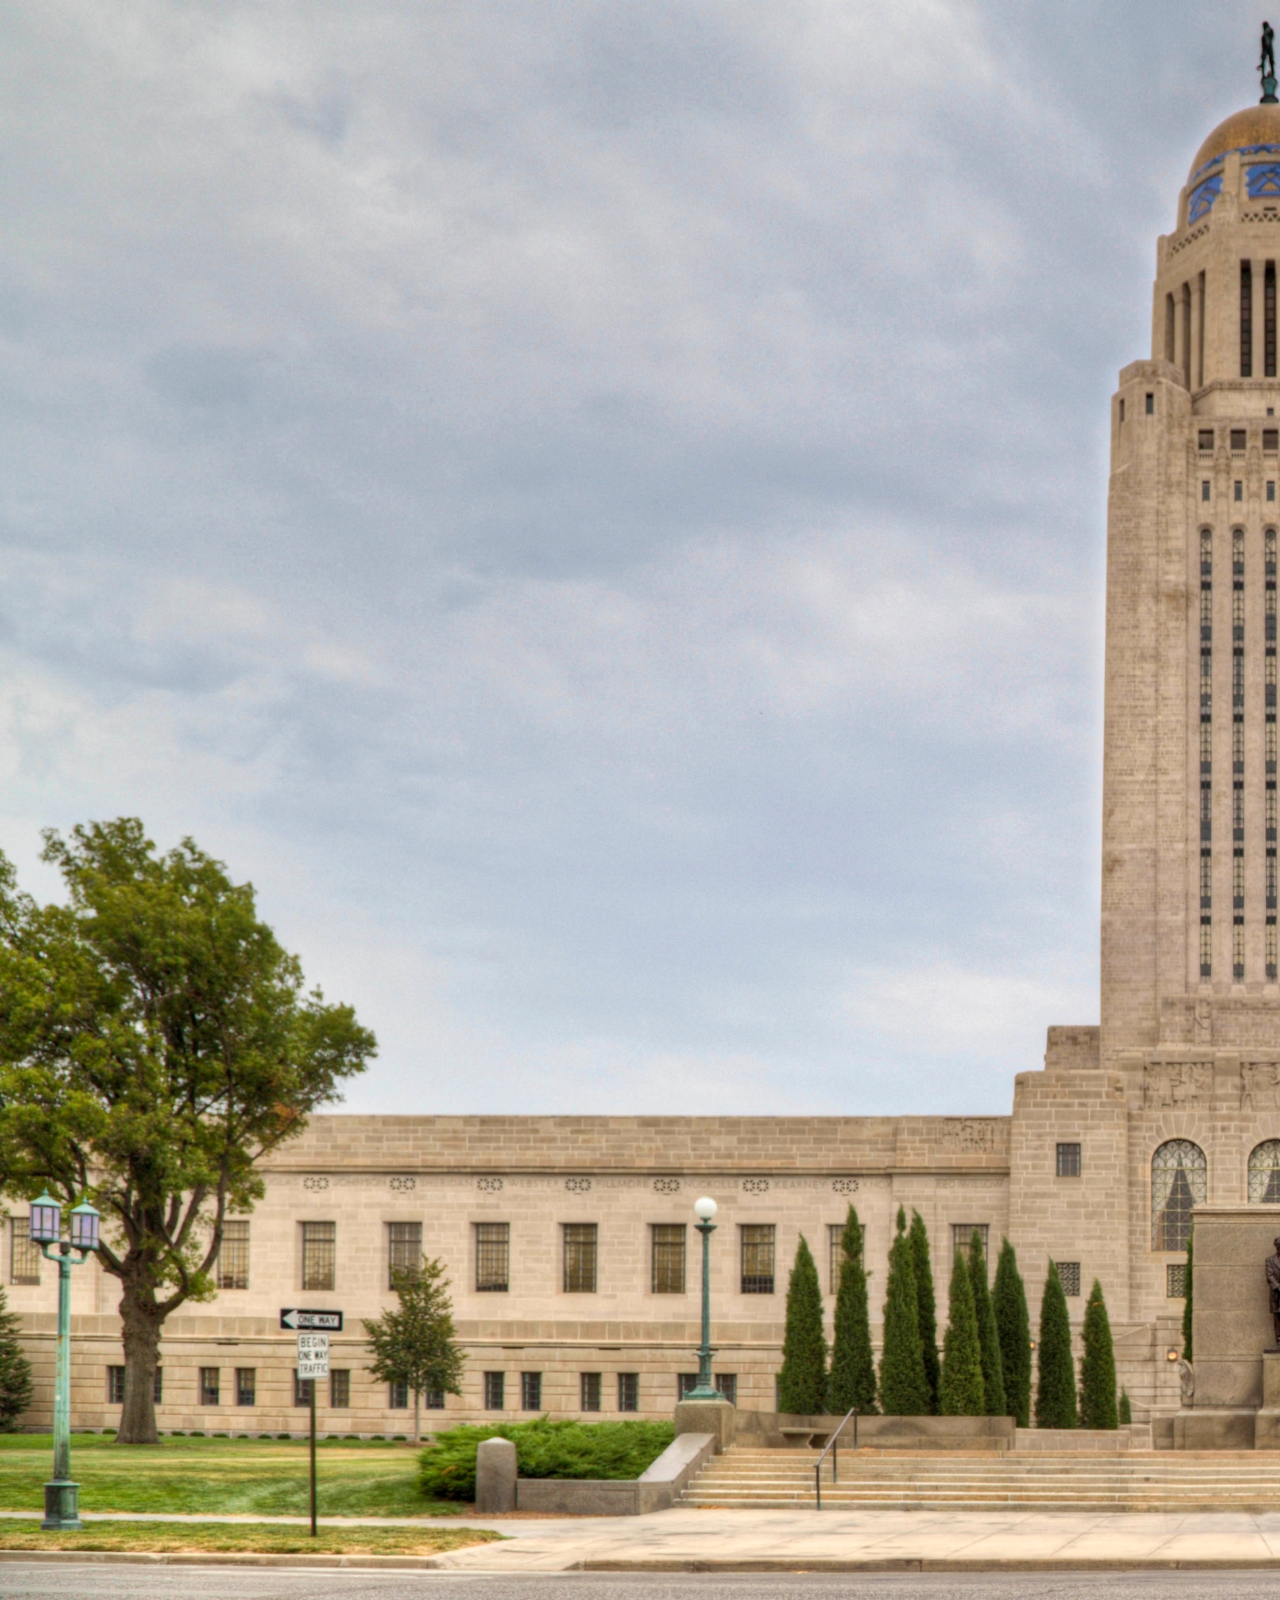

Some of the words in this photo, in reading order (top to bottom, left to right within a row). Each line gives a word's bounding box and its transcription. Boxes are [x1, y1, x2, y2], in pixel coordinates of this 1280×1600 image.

[331, 1178, 386, 1188] JOHNSON
[420, 1178, 473, 1188] SHERIDAN
[508, 1179, 559, 1188] WEBSTER
[596, 1179, 649, 1189] FILLMORE
[683, 1179, 739, 1189] NUCKOLLS
[774, 1180, 827, 1189] KEARNEY
[862, 1180, 891, 1189] KNOX
[936, 1179, 956, 1189] RED
[958, 1179, 1004, 1189] WILLOW
[298, 1315, 315, 1325] ONE
[318, 1316, 336, 1325] WAY
[300, 1337, 326, 1348] BEGIN
[298, 1351, 312, 1361] ONE
[314, 1351, 328, 1360] WAY
[300, 1363, 328, 1374] TRAFFIC
